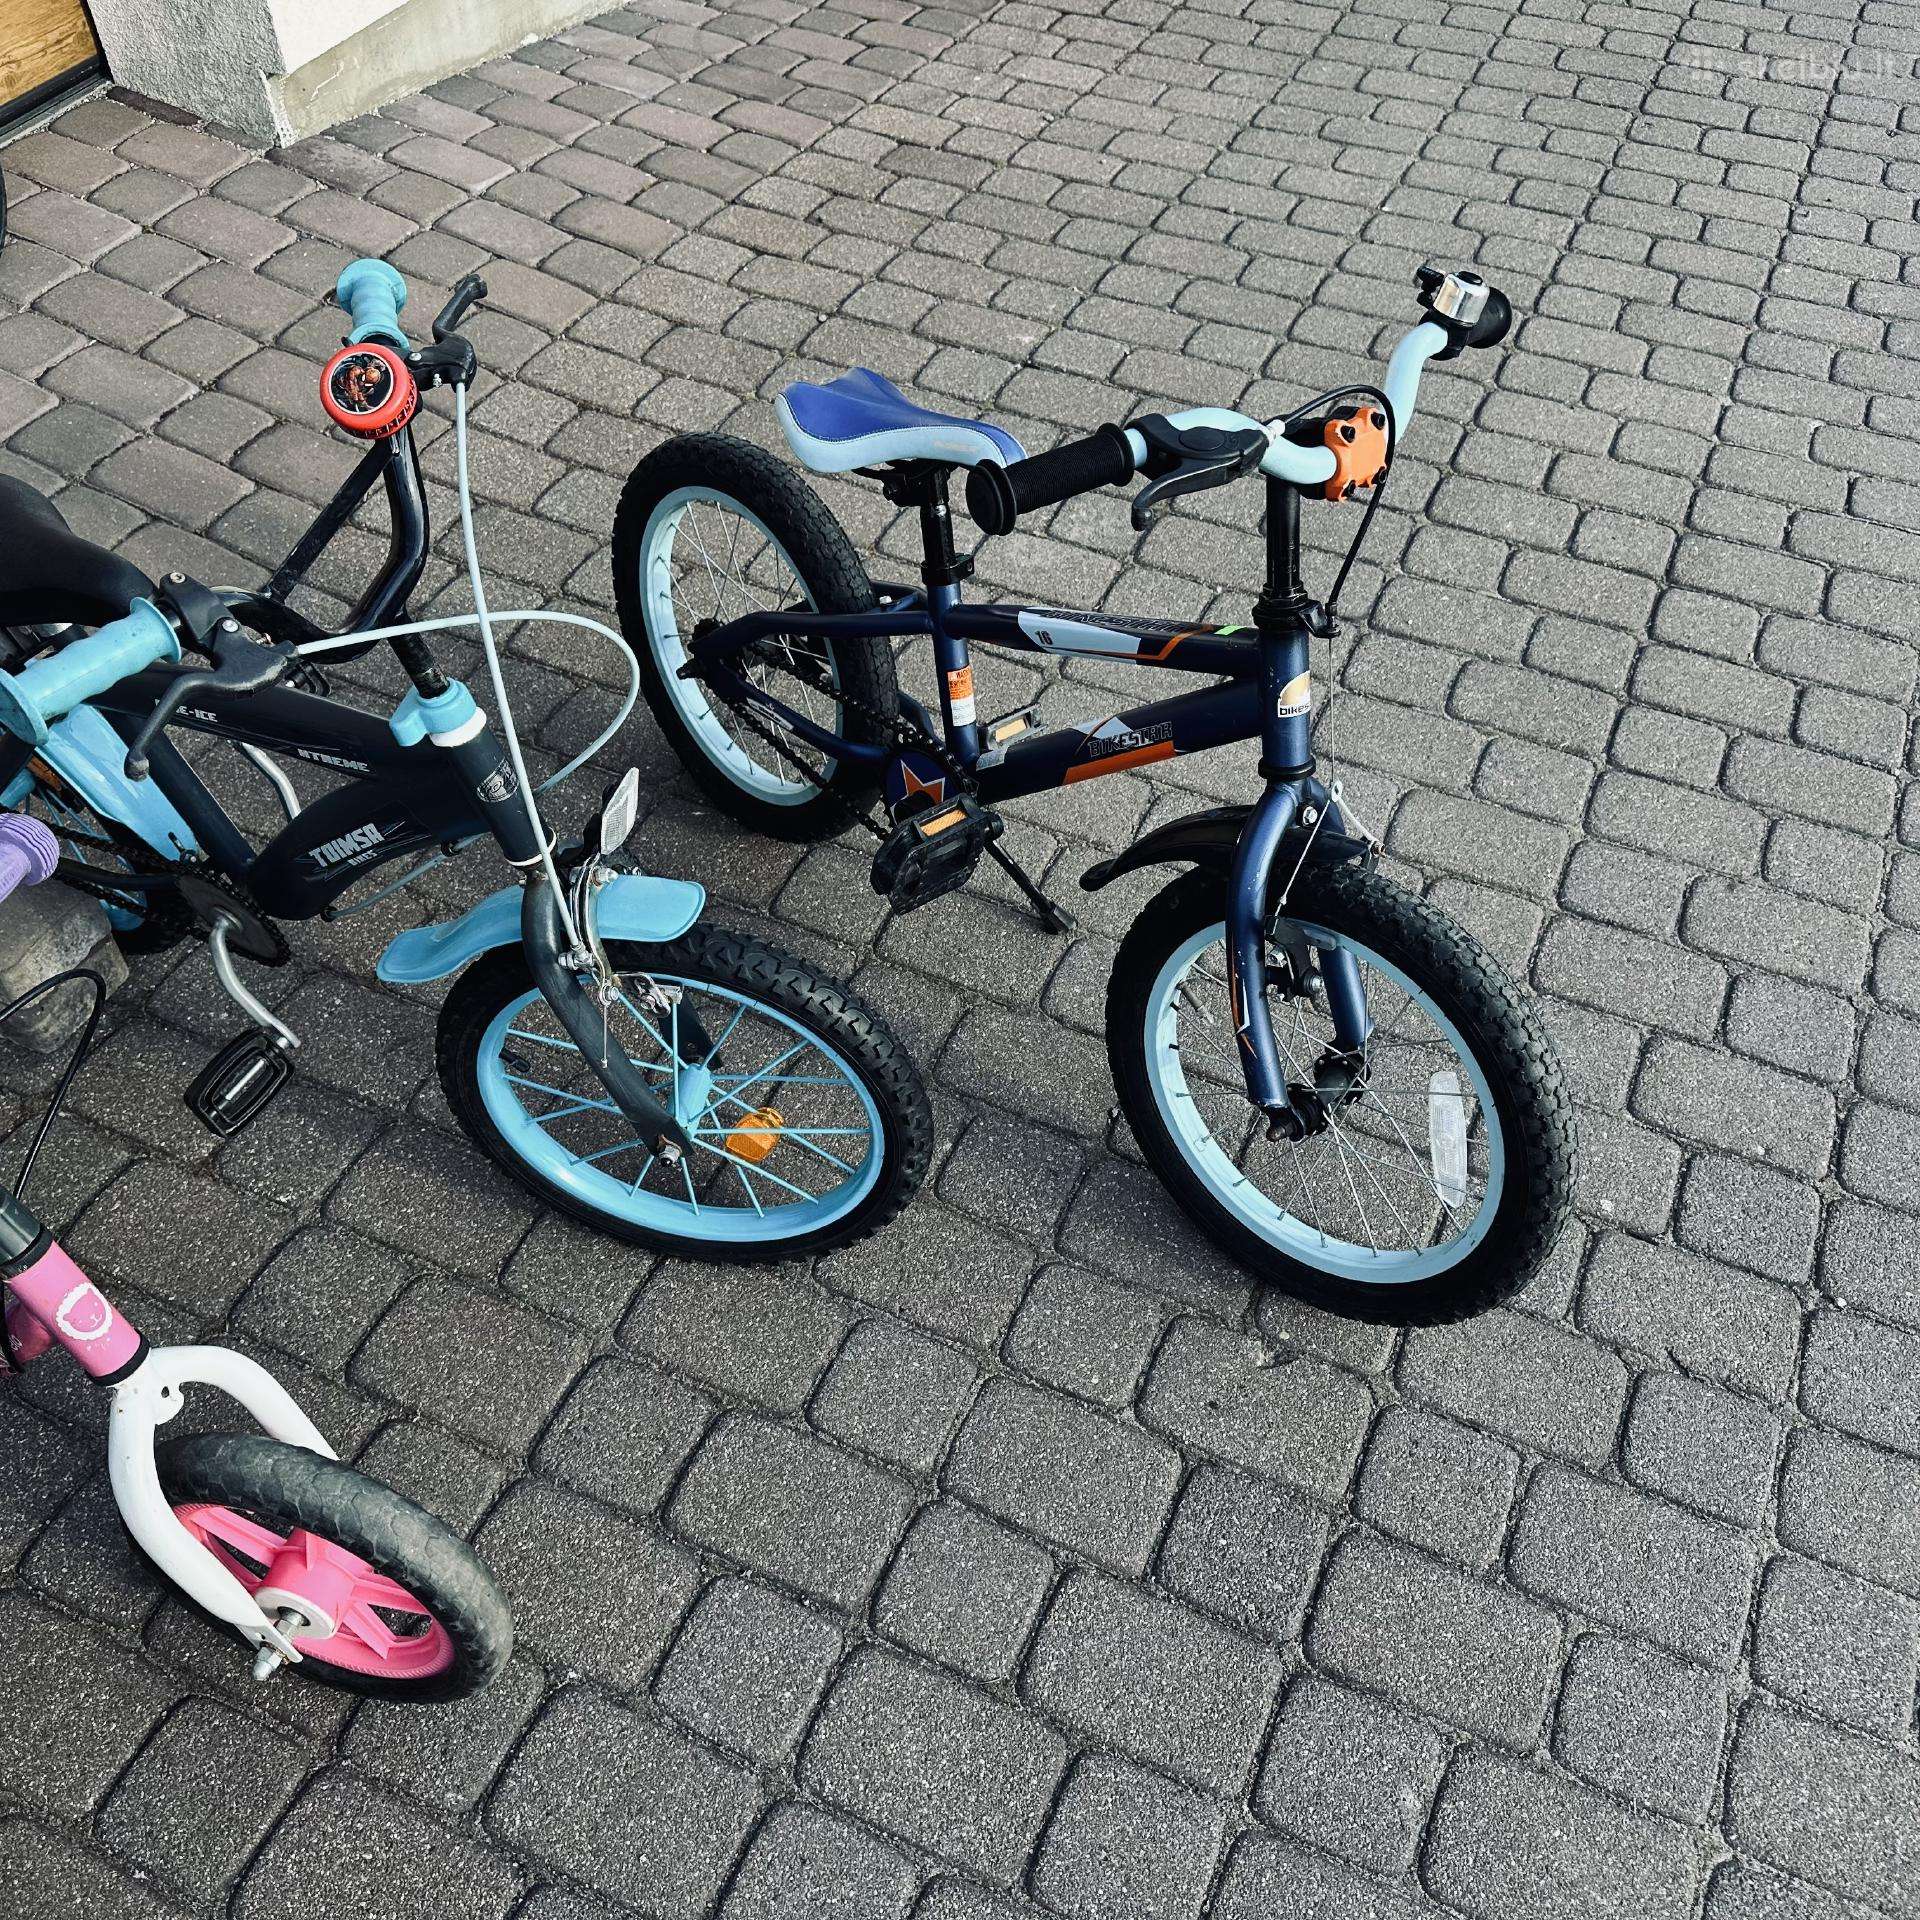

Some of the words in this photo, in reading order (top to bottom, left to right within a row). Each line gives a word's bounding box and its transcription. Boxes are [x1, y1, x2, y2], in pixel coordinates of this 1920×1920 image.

[1034, 630, 1053, 646] 16
[1087, 721, 1173, 758] BIKESTAR
[308, 822, 385, 867] TOIMSA
